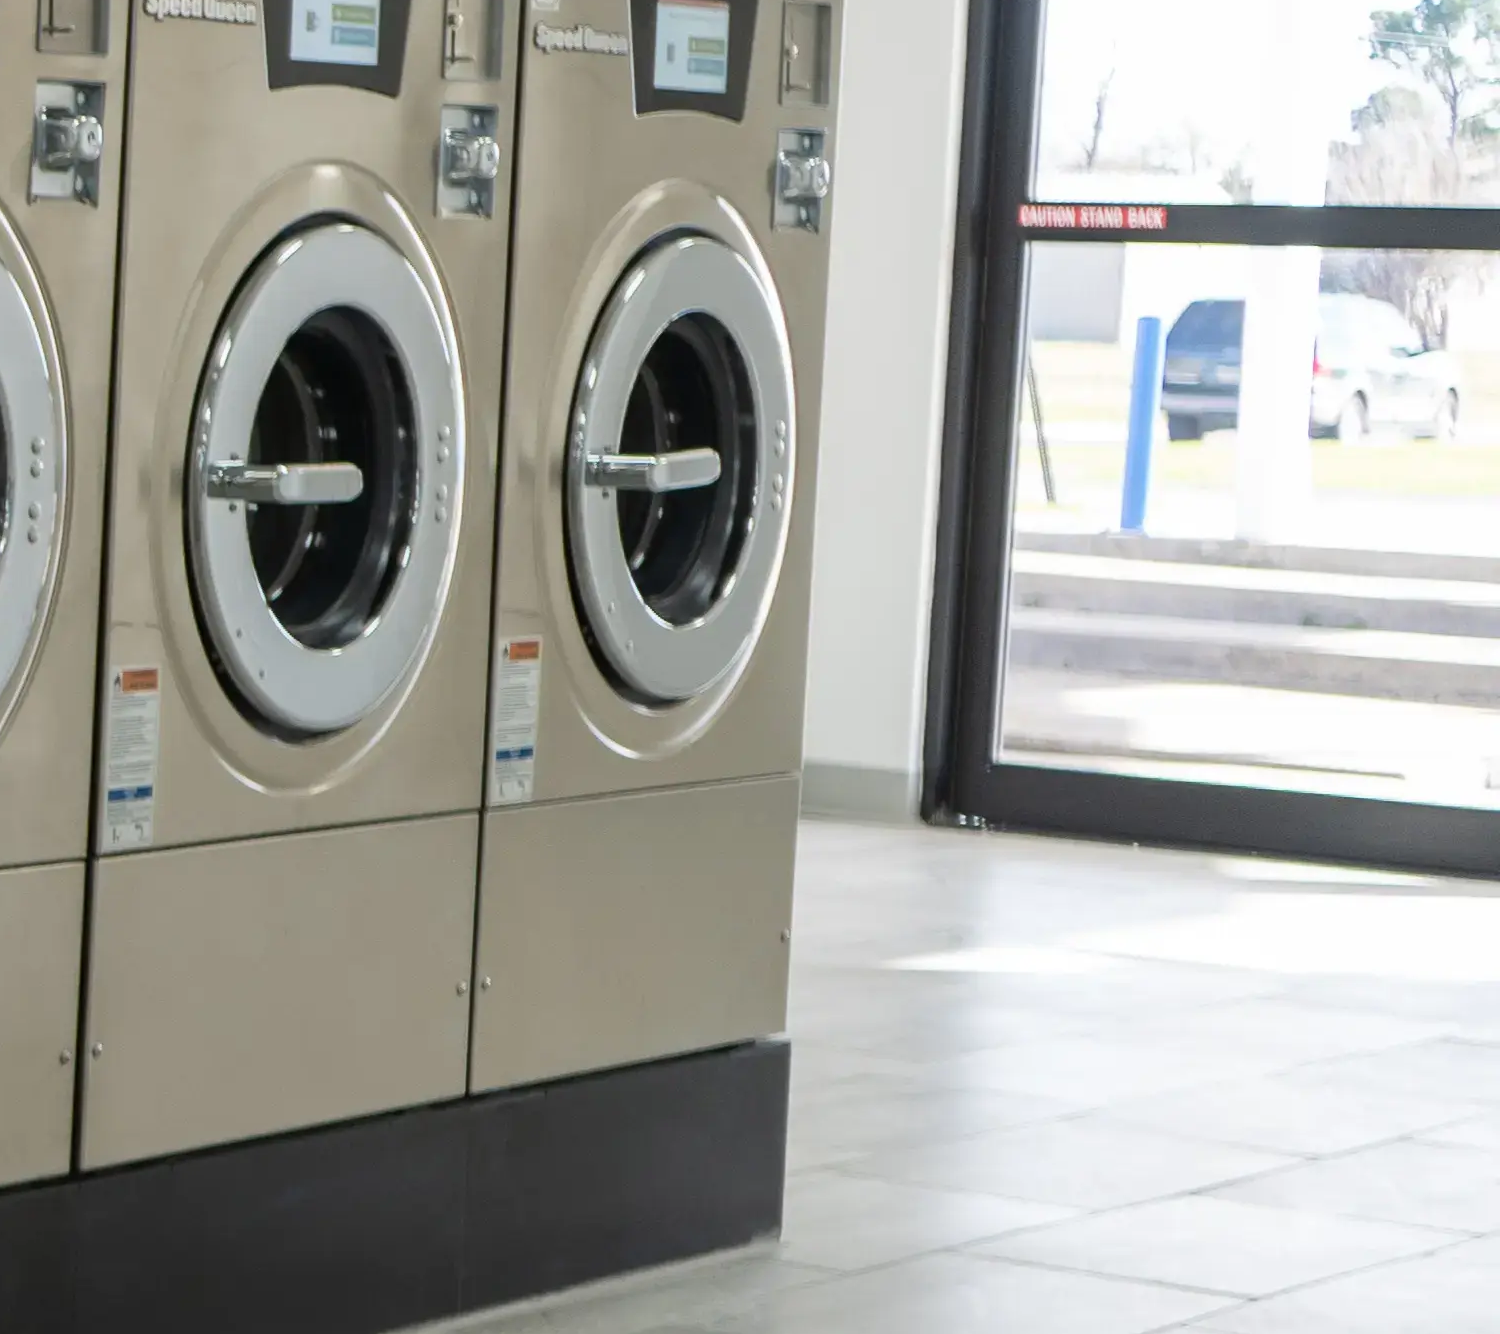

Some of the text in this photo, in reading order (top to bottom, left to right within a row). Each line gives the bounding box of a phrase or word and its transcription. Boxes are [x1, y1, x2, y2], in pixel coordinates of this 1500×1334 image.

[1020, 205, 1163, 228] CAUTION STAND BACK
